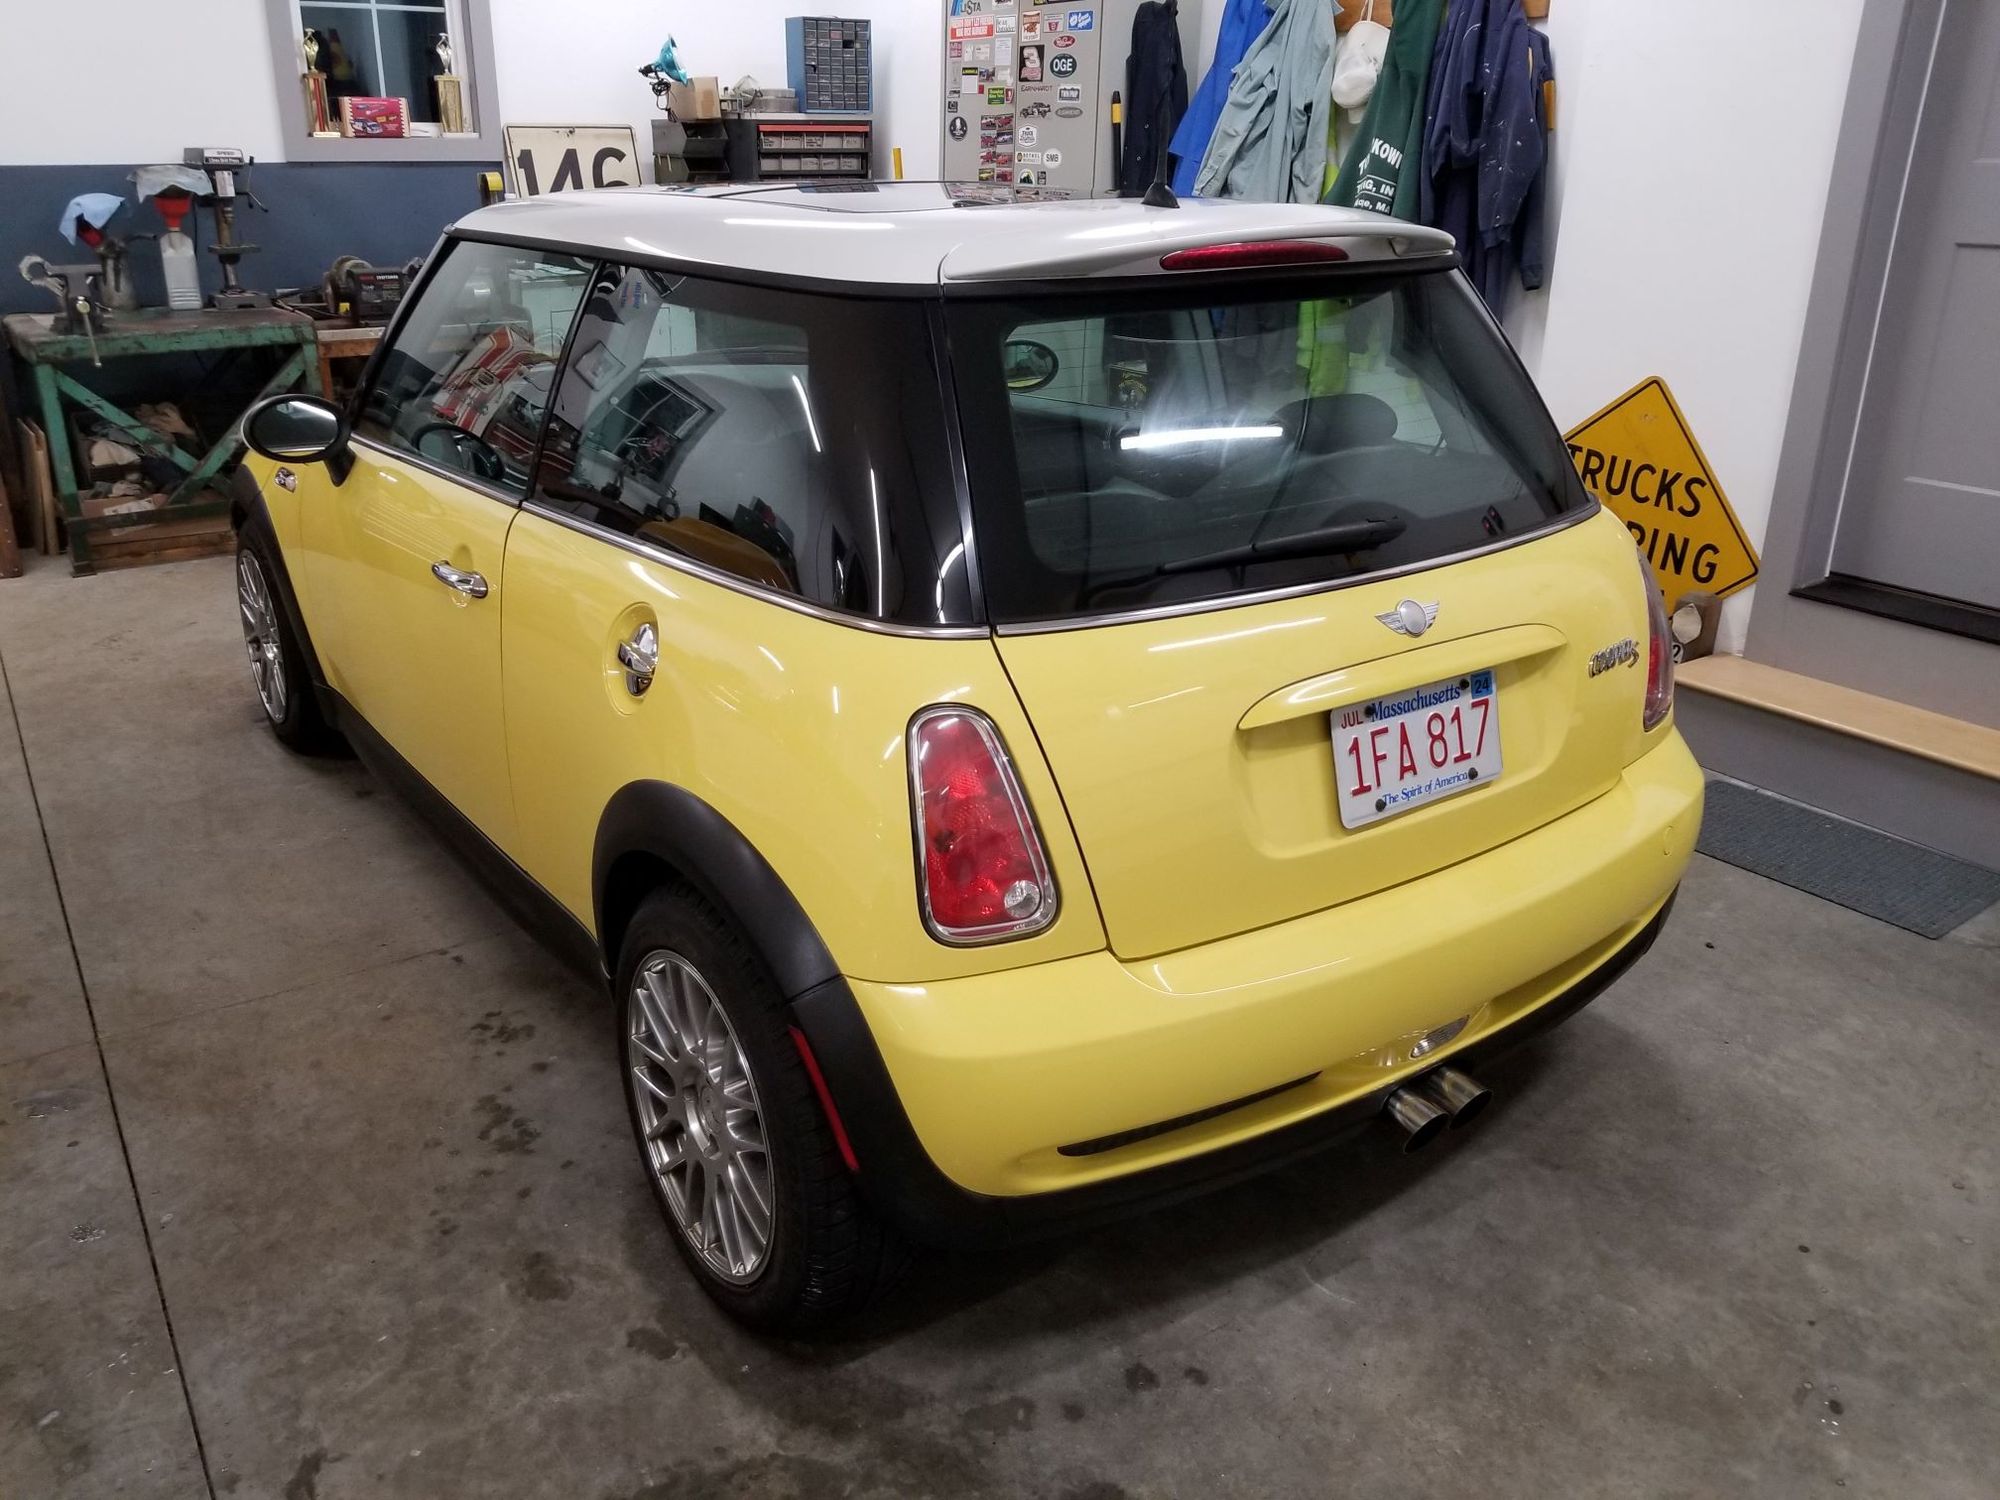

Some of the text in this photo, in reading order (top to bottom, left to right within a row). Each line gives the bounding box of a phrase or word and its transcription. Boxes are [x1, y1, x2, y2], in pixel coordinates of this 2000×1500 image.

[960, 0, 981, 15] LISTA
[1053, 59, 1073, 71] OGE
[1020, 84, 1052, 92] EARNHARDT
[1046, 154, 1059, 162] SMB
[1371, 137, 1403, 169] KOWI
[517, 147, 630, 196] 146
[1567, 443, 1707, 518] TRUCKS
[1474, 677, 1490, 694] 24
[1371, 684, 1461, 722] Massachusetts
[1341, 710, 1364, 729] JUL
[1348, 698, 1490, 797] 1FA 817
[1383, 771, 1468, 806] The Spirit of America
